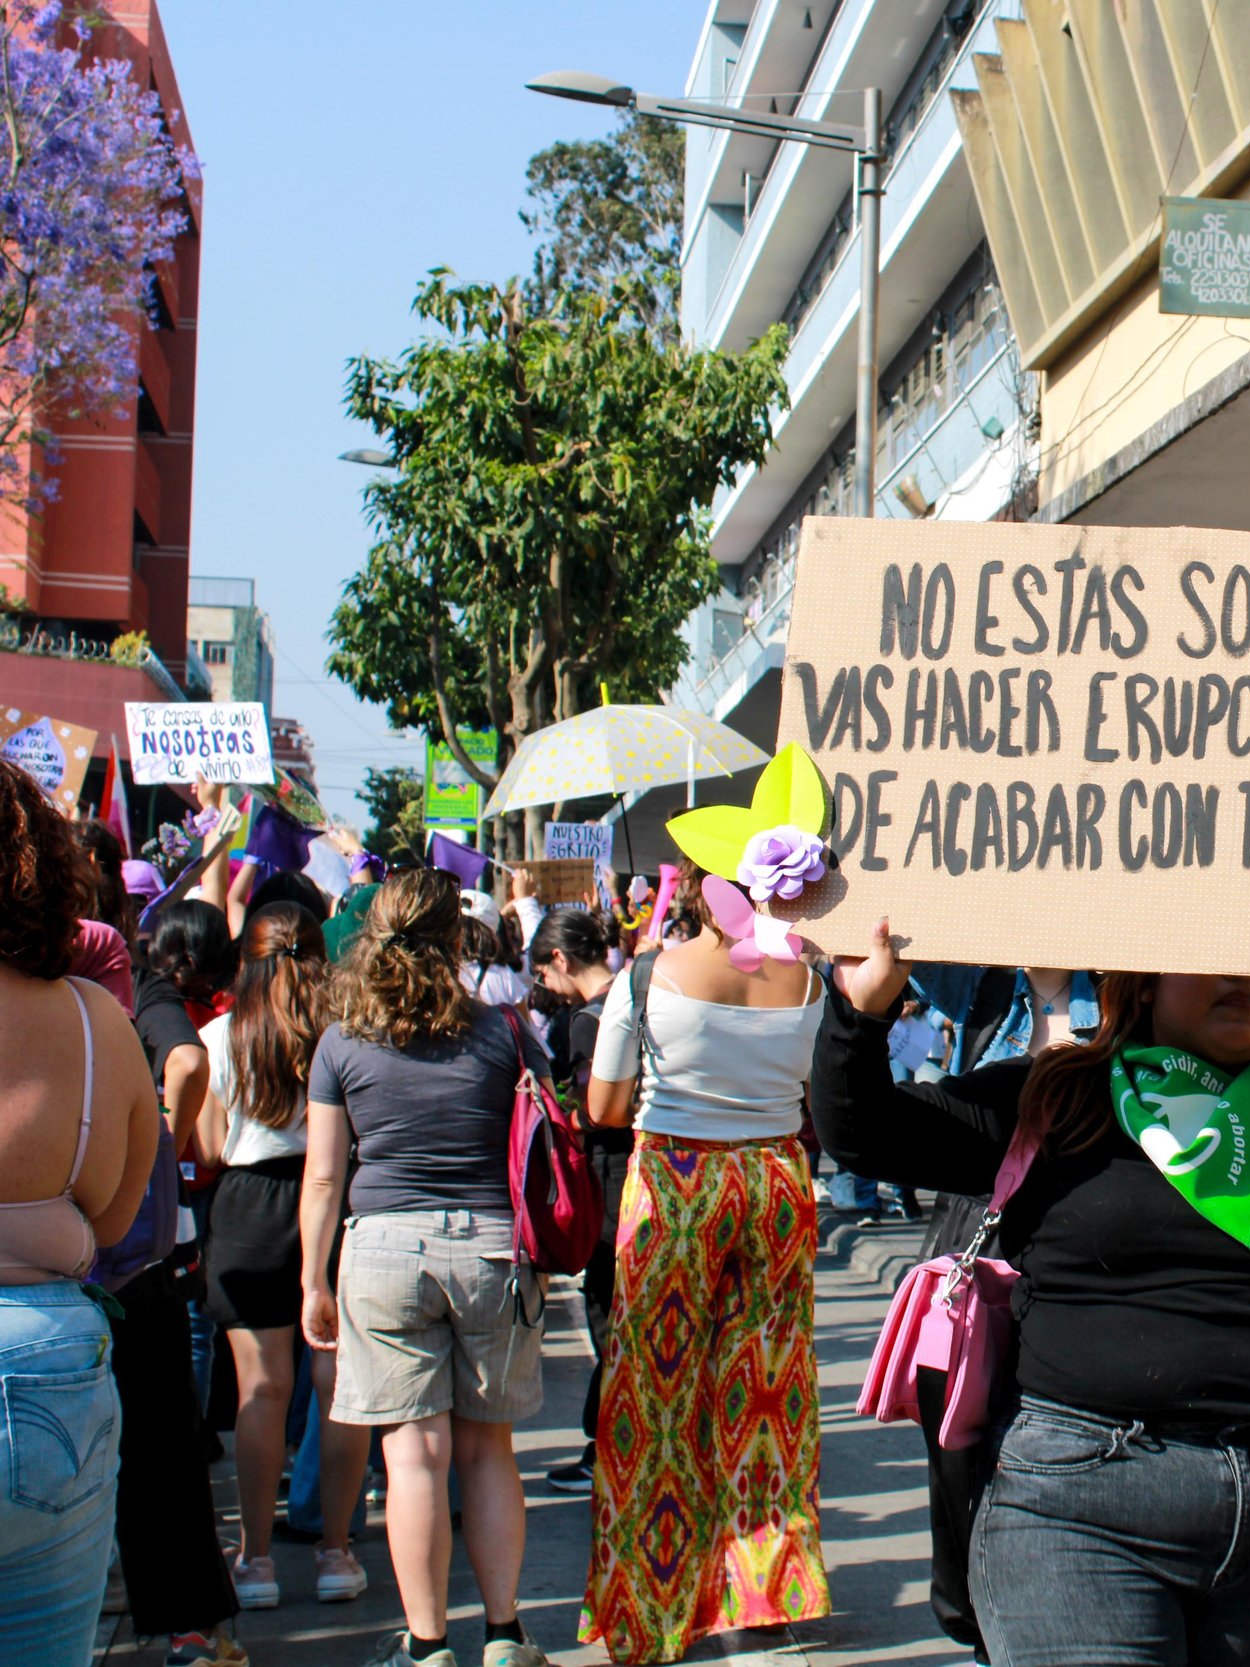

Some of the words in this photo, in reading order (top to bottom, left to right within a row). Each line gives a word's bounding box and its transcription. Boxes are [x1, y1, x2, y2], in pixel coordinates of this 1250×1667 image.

[1201, 213, 1228, 234] SE
[879, 561, 956, 660] NO
[973, 555, 1149, 659] ESTAS
[210, 708, 226, 726] de
[793, 661, 894, 752] VAS
[902, 666, 1062, 758] HACER
[26, 727, 45, 738] POR
[167, 758, 188, 779] de
[200, 758, 242, 780] vivirlo
[552, 825, 604, 842] NUESTRO
[828, 769, 898, 872] DE
[903, 778, 1107, 877] ACABAR
[1118, 778, 1220, 872] CON
[1227, 1112, 1247, 1187] abortar
